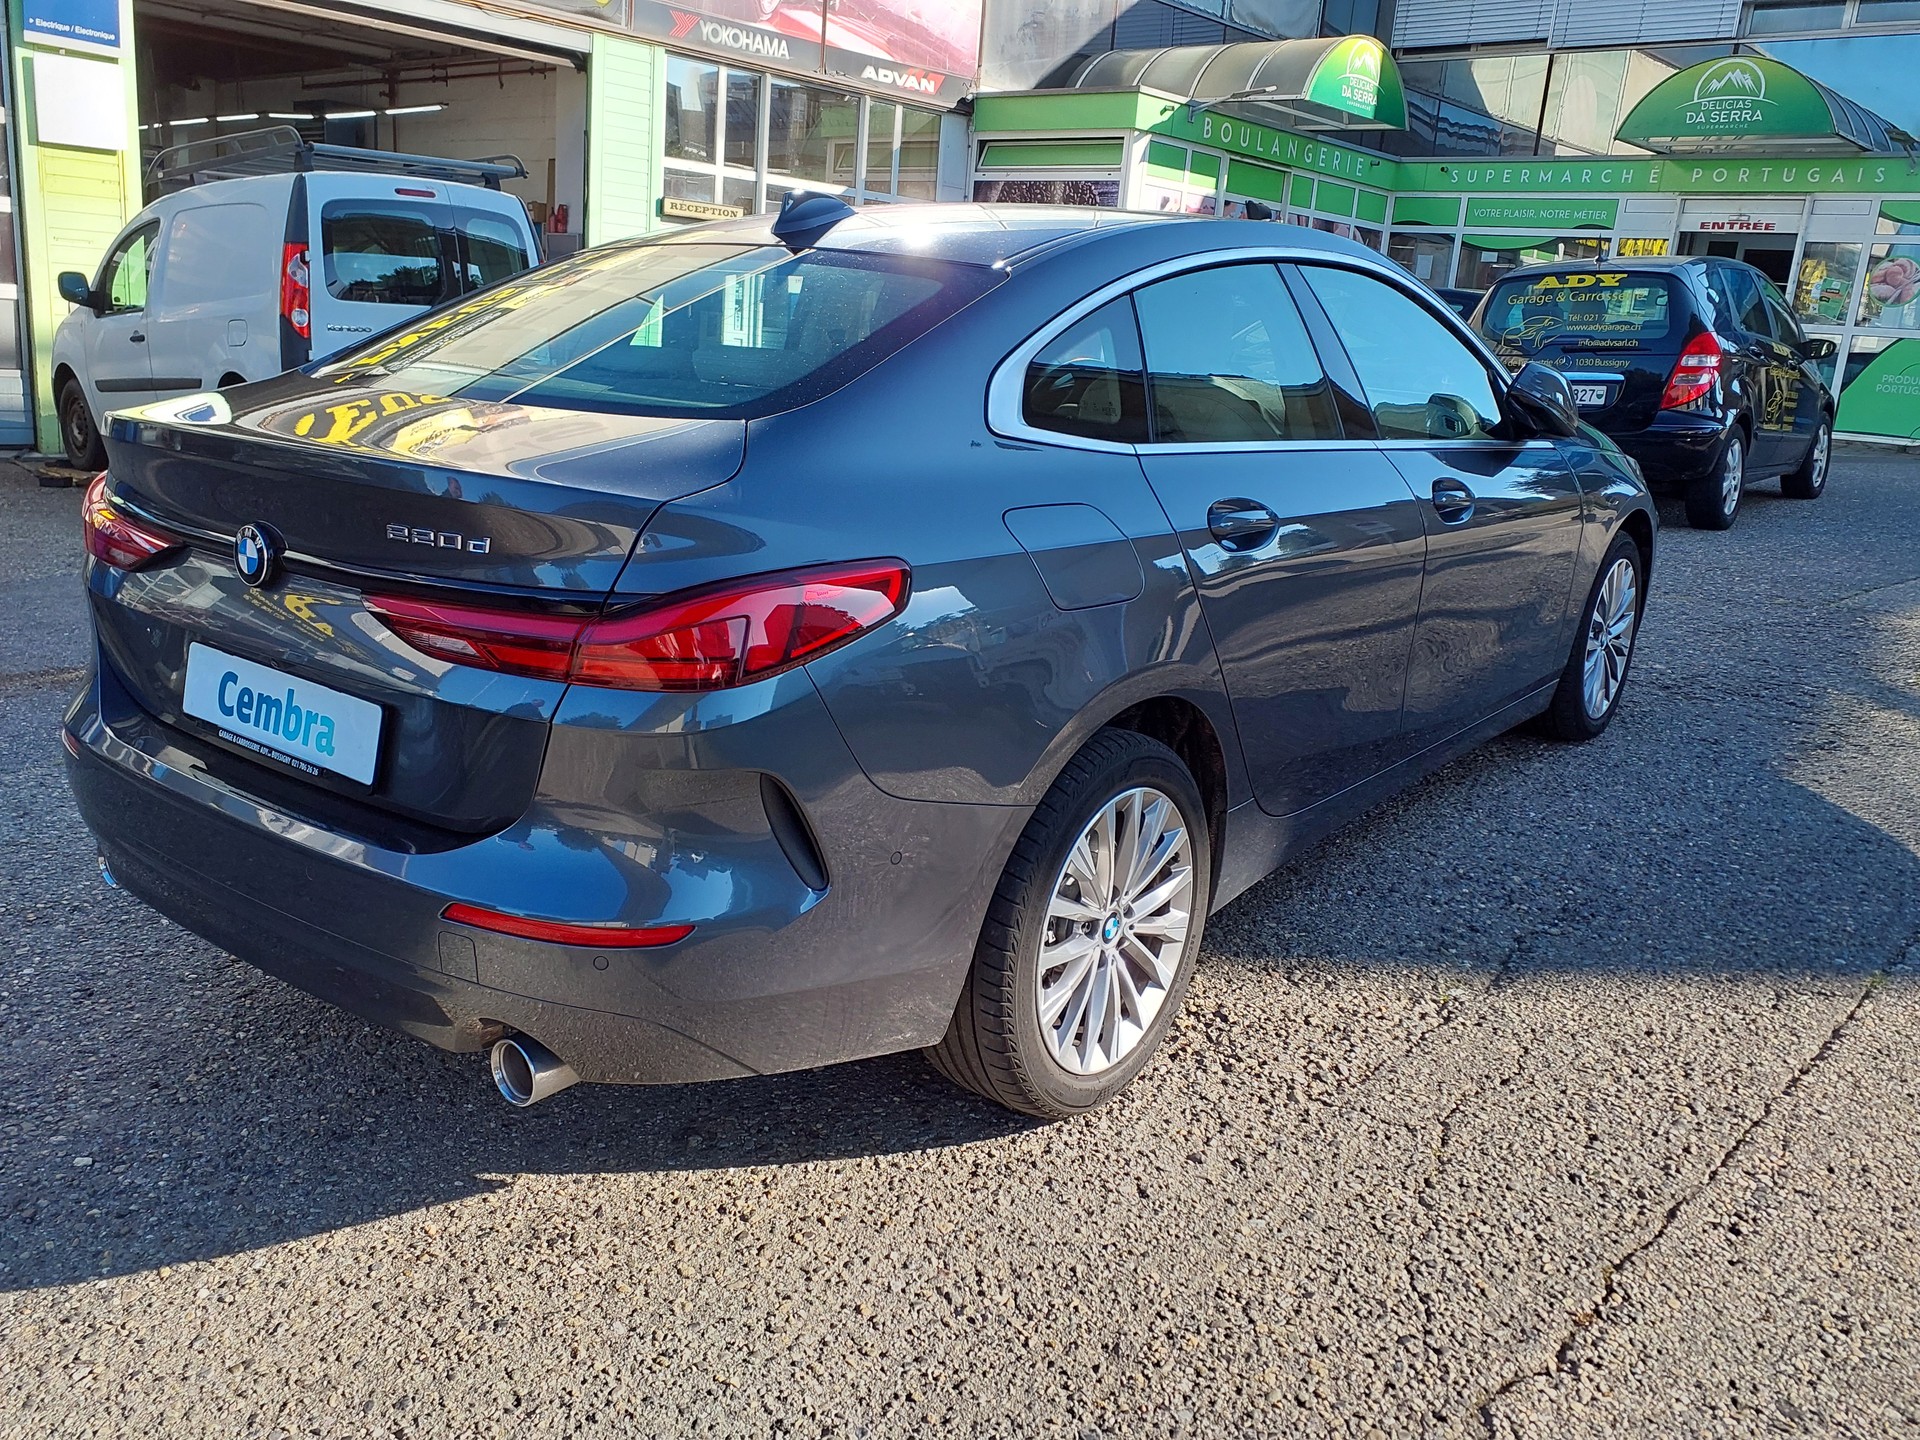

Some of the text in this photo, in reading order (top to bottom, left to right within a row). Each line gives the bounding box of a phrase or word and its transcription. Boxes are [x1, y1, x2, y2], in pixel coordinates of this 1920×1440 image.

[35, 18, 70, 32] Electrique
[75, 25, 115, 40] Electronique
[699, 20, 789, 59] YOKOHAMA
[860, 65, 936, 93] ADVAN
[1350, 76, 1374, 92] DELICIAS
[1341, 84, 1377, 106] DA SERRA
[1701, 100, 1752, 111] DELICIAS
[1686, 109, 1763, 124] DA SERRA
[1203, 117, 1364, 177] BOULANGERIE
[1451, 165, 1886, 184] SUPERMARCHÉ PORTUGAIS
[670, 202, 738, 217] RECEPTION
[1473, 208, 1607, 220] VOTRE PLAISIR, NOTRE MÉTIER
[1700, 220, 1777, 231] ENTRÉE
[1533, 273, 1628, 289] ADY
[1507, 289, 1645, 306] Garage & Carrossee
[1568, 313, 1583, 322] Tél:
[1583, 313, 1599, 322] 021
[1566, 323, 1643, 333] www.adygarage.ch
[1575, 357, 1631, 369] 1030 Bussigny
[1876, 384, 1920, 396] PORTUG
[386, 523, 491, 554] 220d
[218, 670, 336, 757] Cembra
[218, 729, 233, 742] GARAGE
[236, 737, 260, 752] CARROSSERIE
[271, 750, 291, 765] BUSSIGNY
[291, 759, 299, 768] 021
